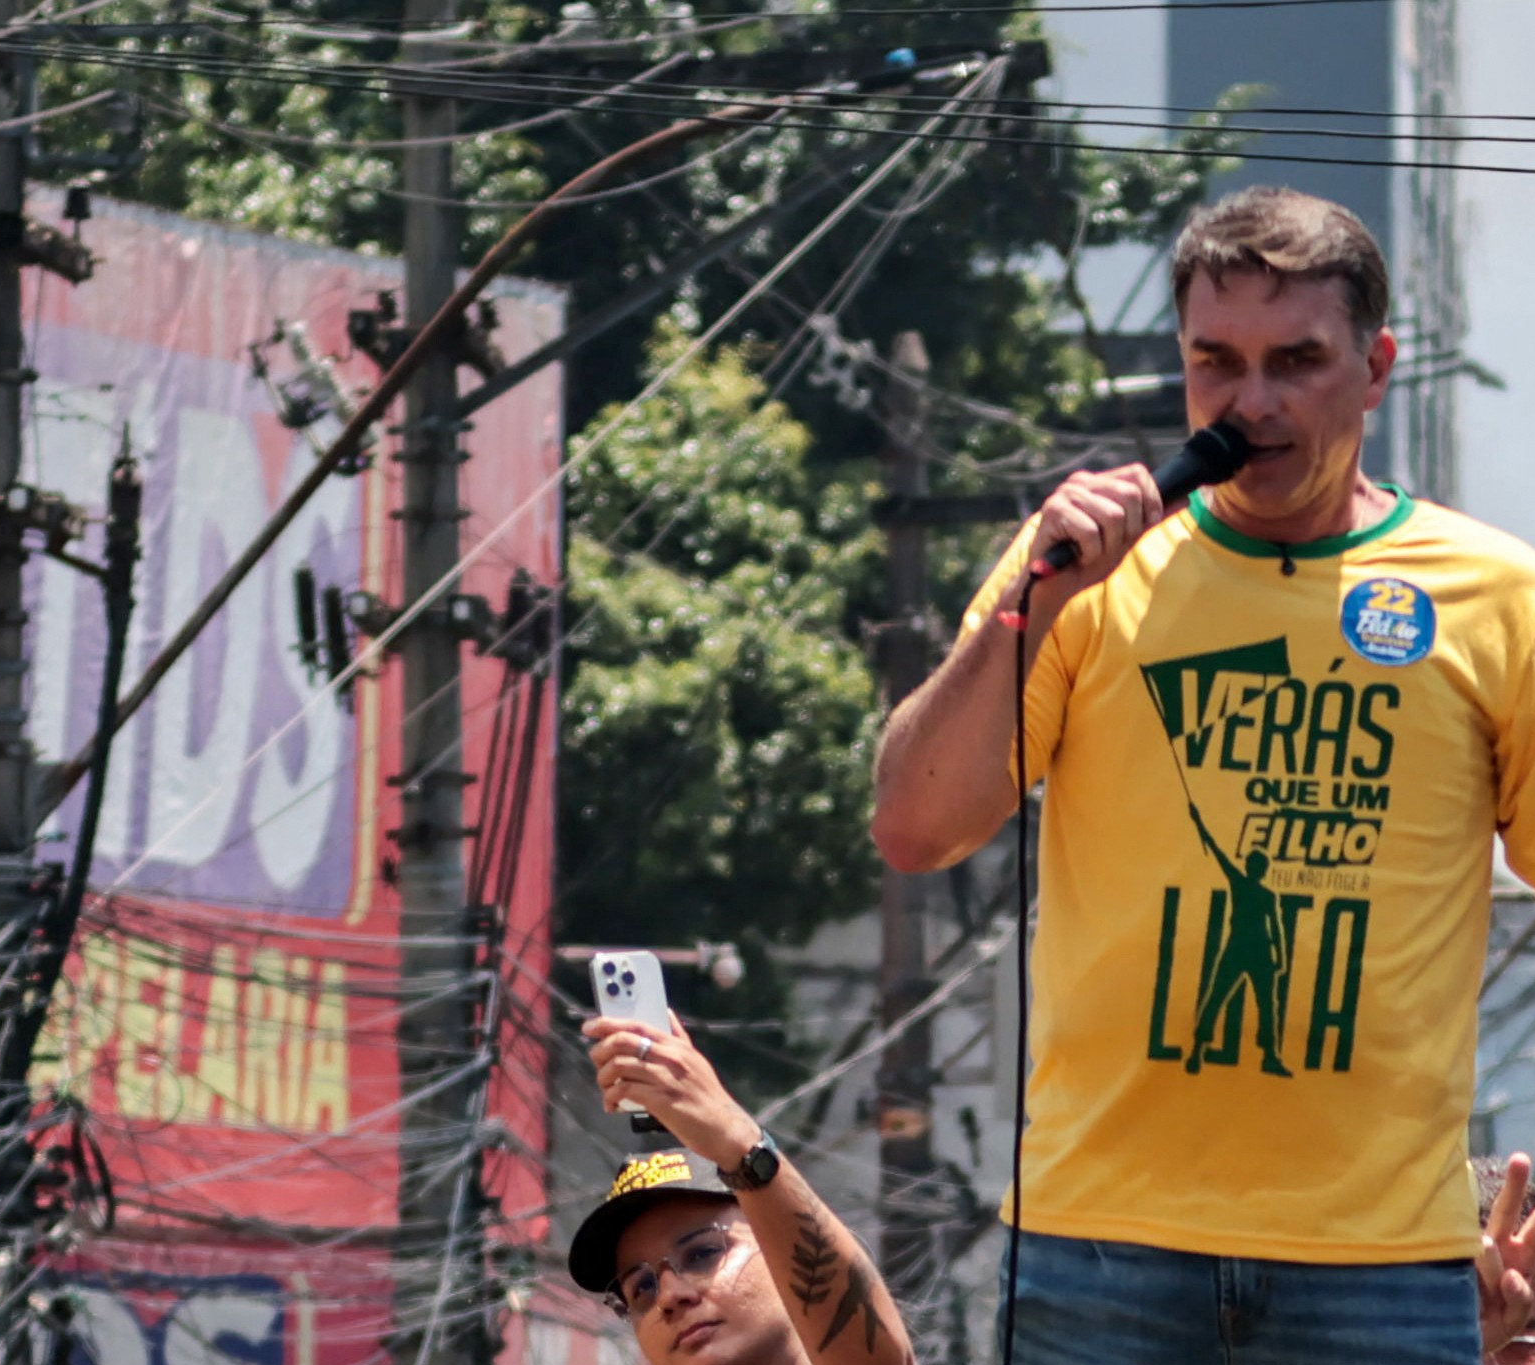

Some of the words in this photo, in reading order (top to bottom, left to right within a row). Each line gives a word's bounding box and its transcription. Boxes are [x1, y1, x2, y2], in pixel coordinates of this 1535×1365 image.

[1367, 583, 1415, 615] 22
[1180, 657, 1401, 778] VERÁS
[1245, 778, 1319, 806] QUE
[1332, 782, 1390, 811] UM
[1239, 816, 1379, 862] FILHO
[25, 930, 351, 1136] APELARIA
